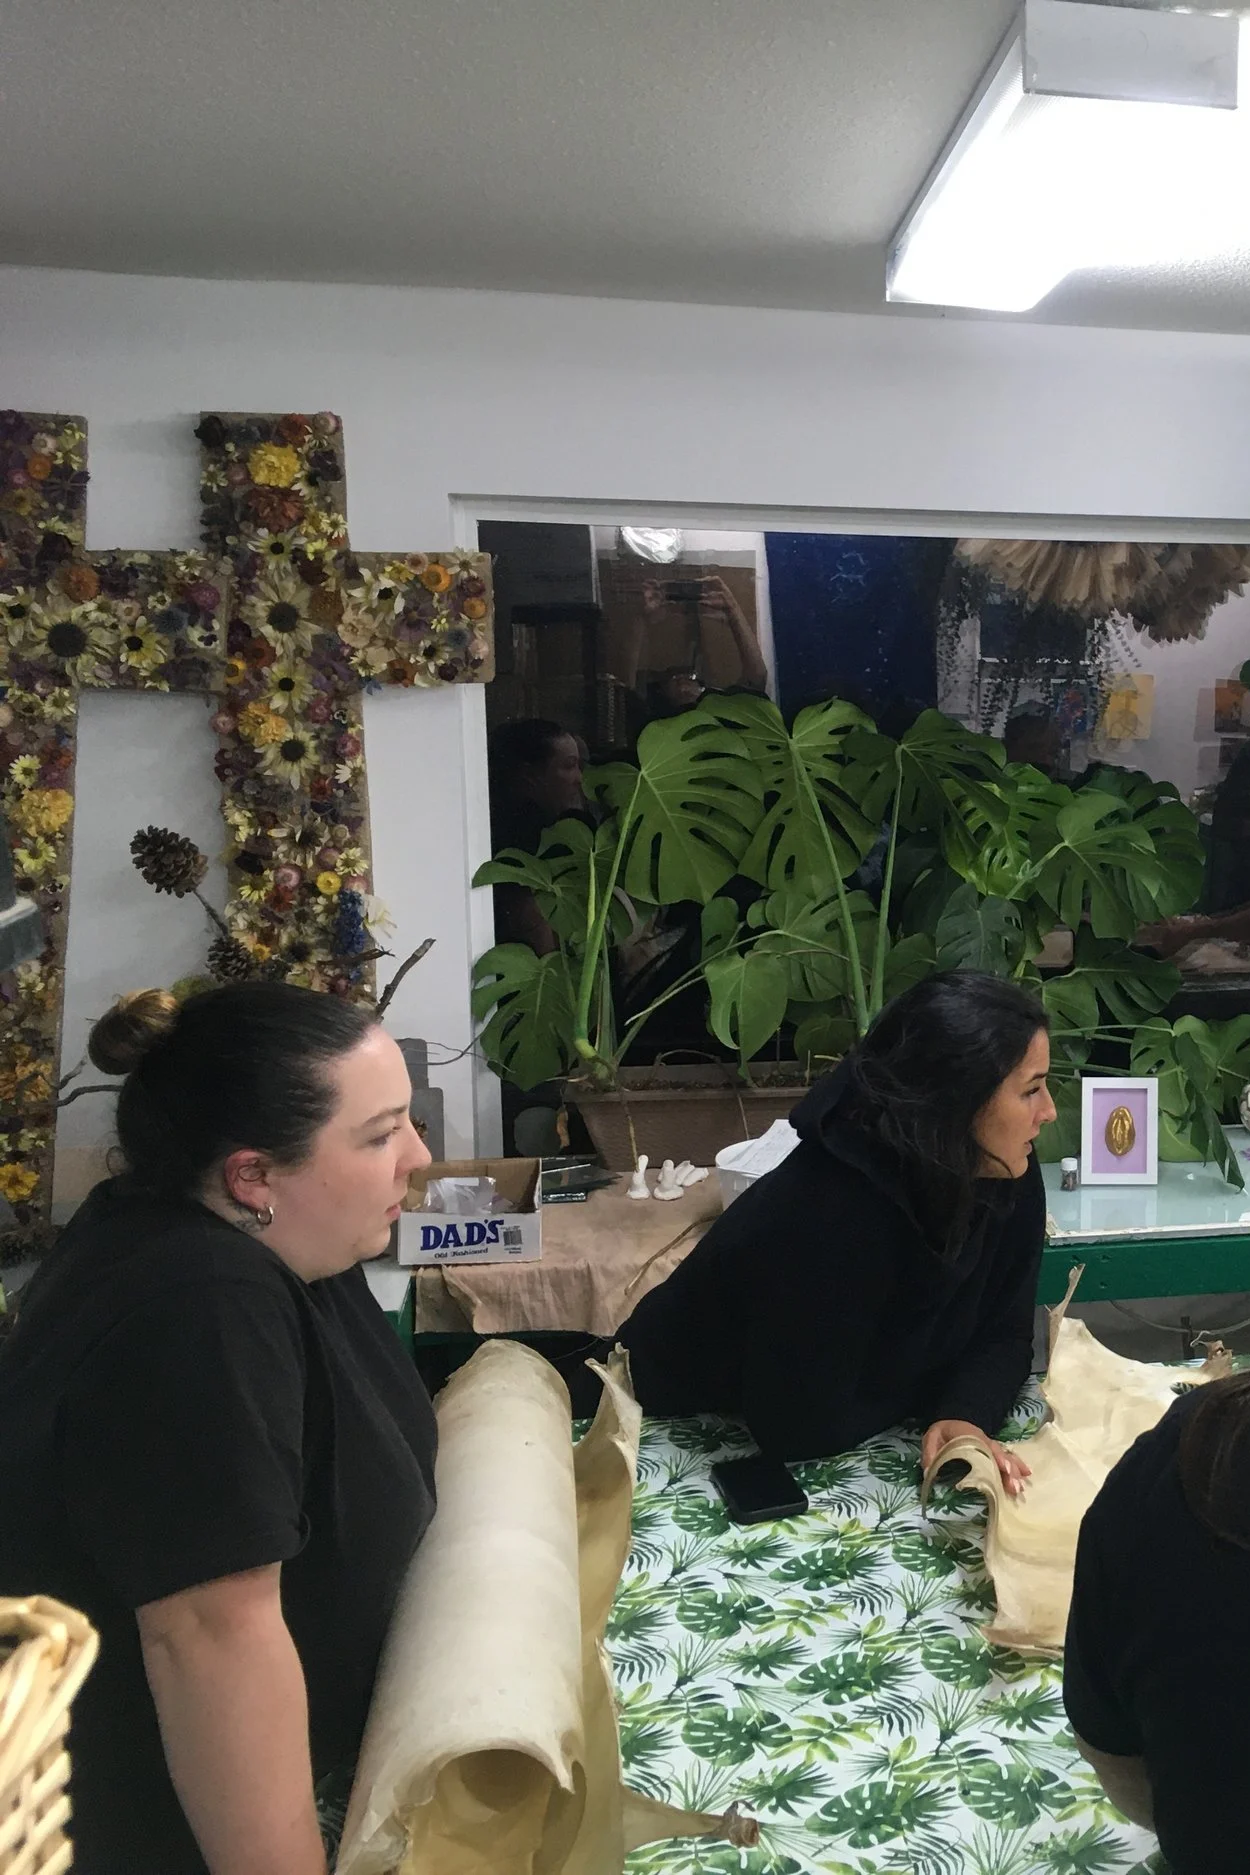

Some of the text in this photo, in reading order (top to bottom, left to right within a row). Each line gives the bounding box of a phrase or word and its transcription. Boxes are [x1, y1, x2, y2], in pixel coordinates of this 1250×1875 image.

[420, 1219, 504, 1250] DAD'S
[434, 1247, 489, 1259] Old Fashioned
